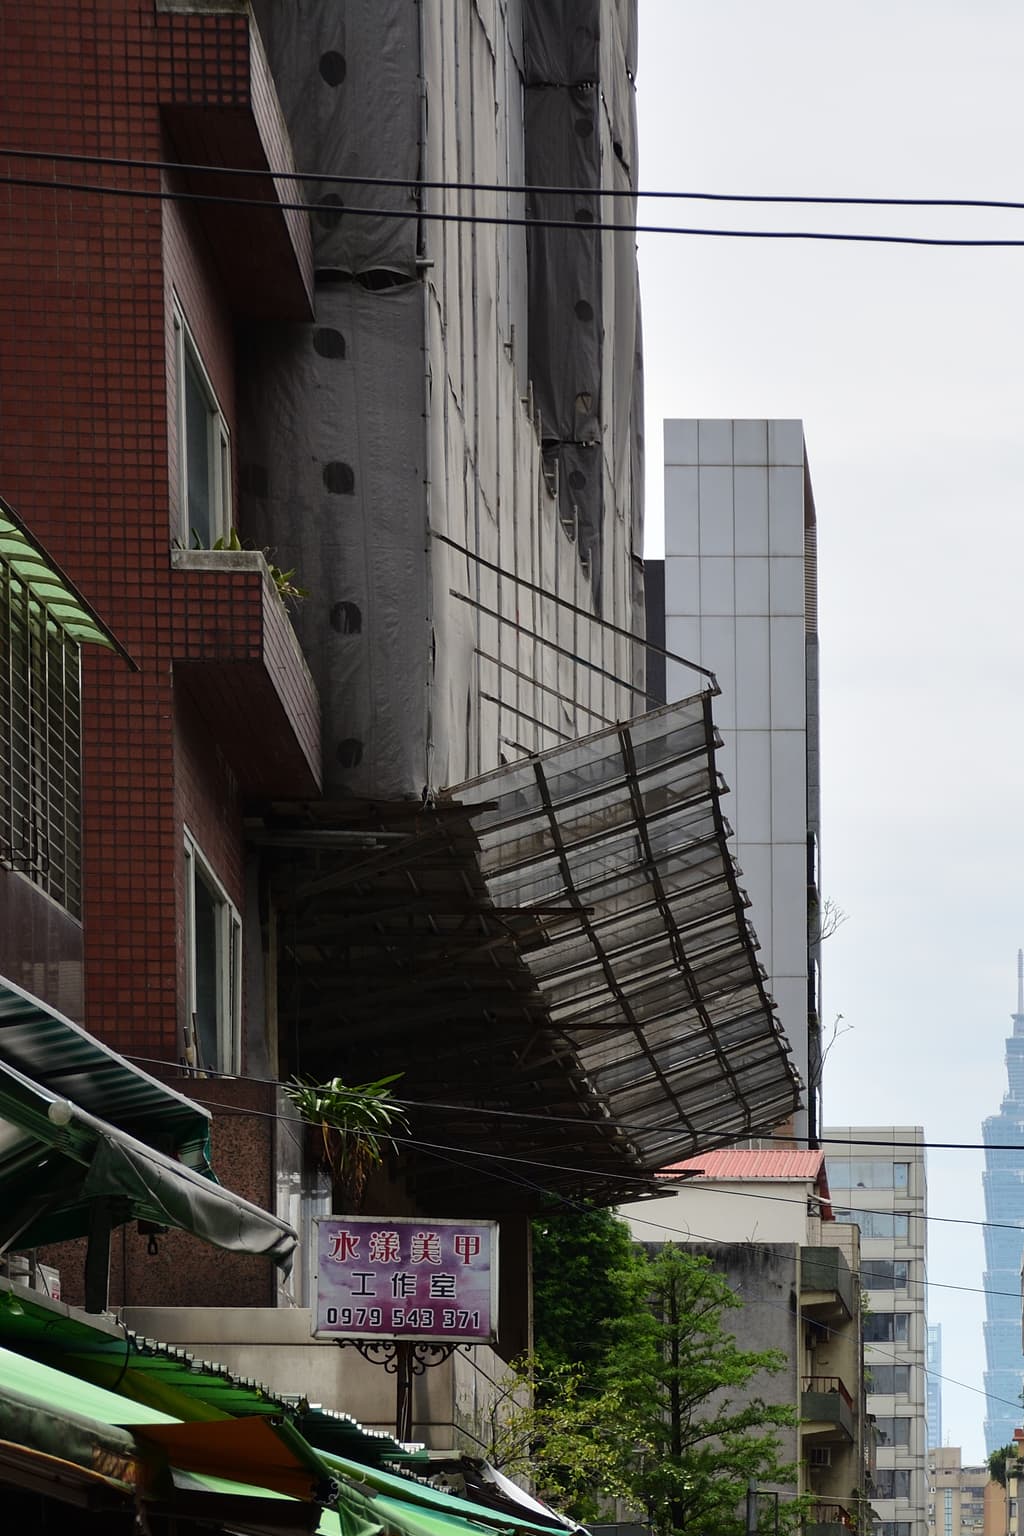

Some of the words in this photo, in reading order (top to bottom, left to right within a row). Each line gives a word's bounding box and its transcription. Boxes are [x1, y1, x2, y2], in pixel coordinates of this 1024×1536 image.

[328, 1230, 481, 1265] 水漾美甲
[351, 1272, 456, 1298] 工作室
[327, 1308, 381, 1326] 0979
[392, 1309, 433, 1328] 543
[443, 1310, 480, 1328] 371
